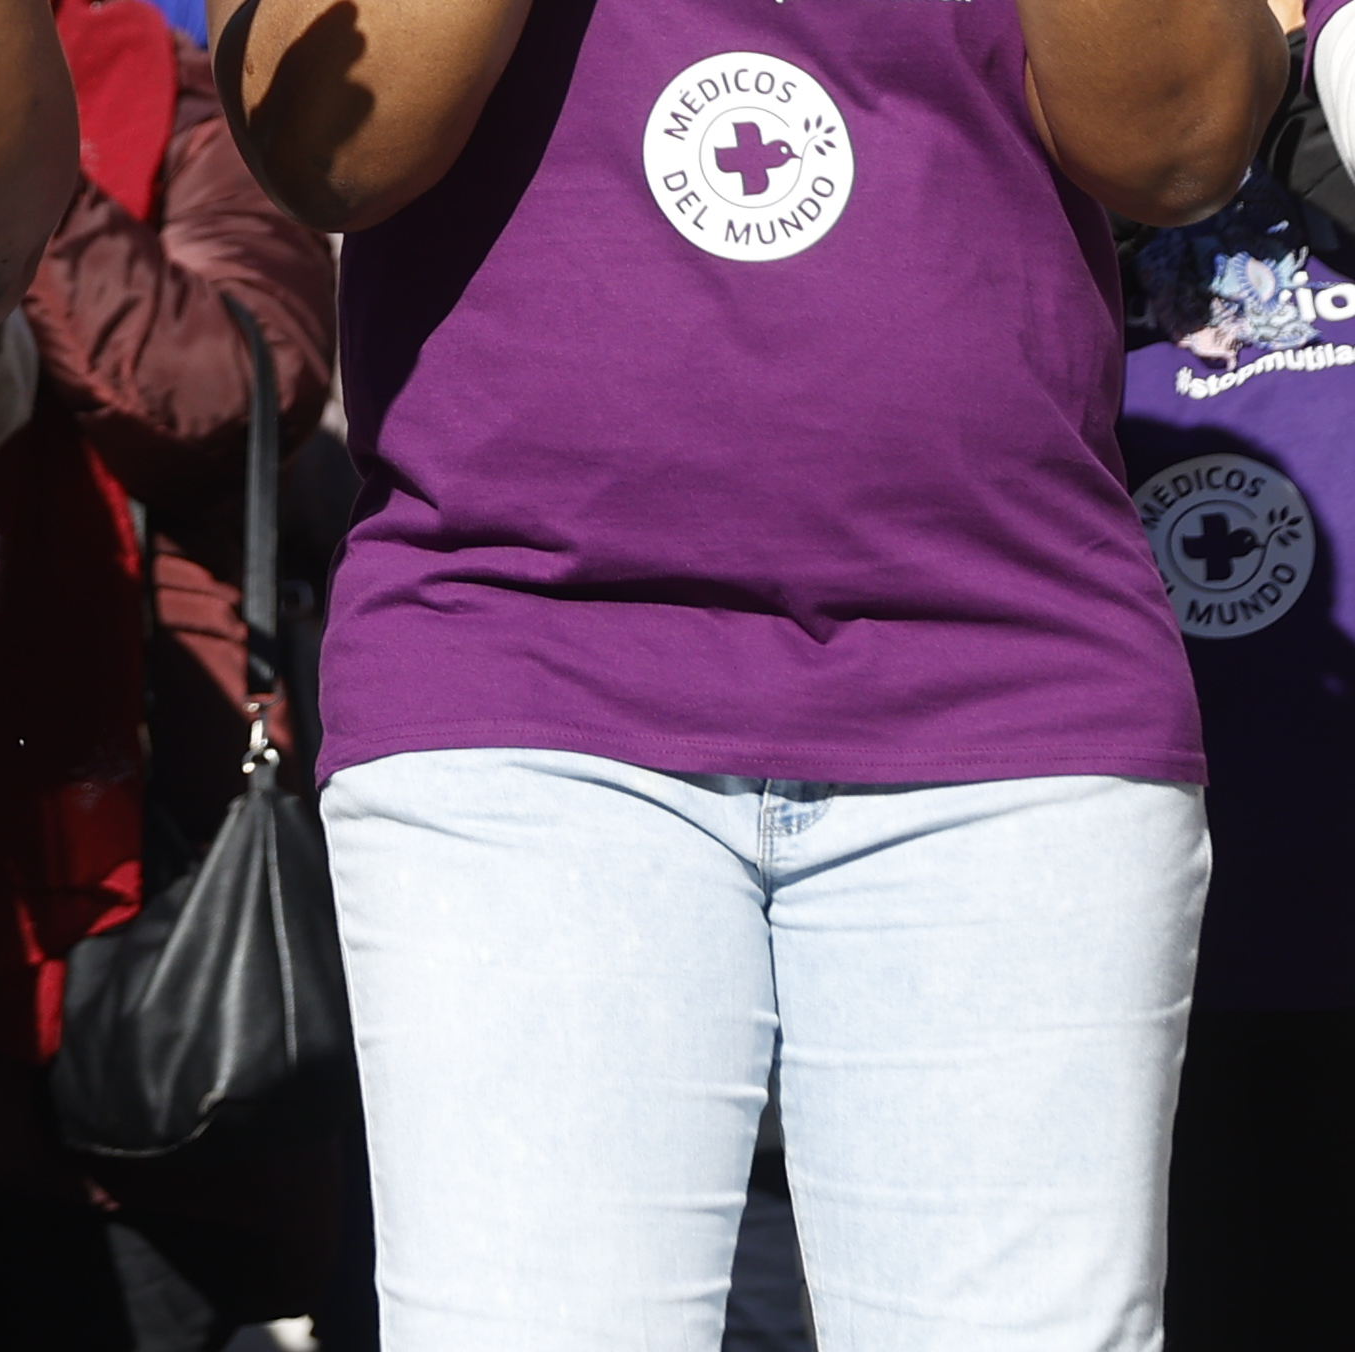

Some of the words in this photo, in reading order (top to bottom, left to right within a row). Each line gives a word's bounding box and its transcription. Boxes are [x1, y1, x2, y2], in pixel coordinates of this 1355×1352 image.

[663, 68, 797, 141] MÉDICOS
[663, 170, 708, 231] DEL
[725, 176, 835, 246] MUNDO
[1175, 342, 1355, 399] #stopmutila
[1141, 466, 1267, 530] MÉDICOS
[1186, 562, 1297, 625] MUNDO
